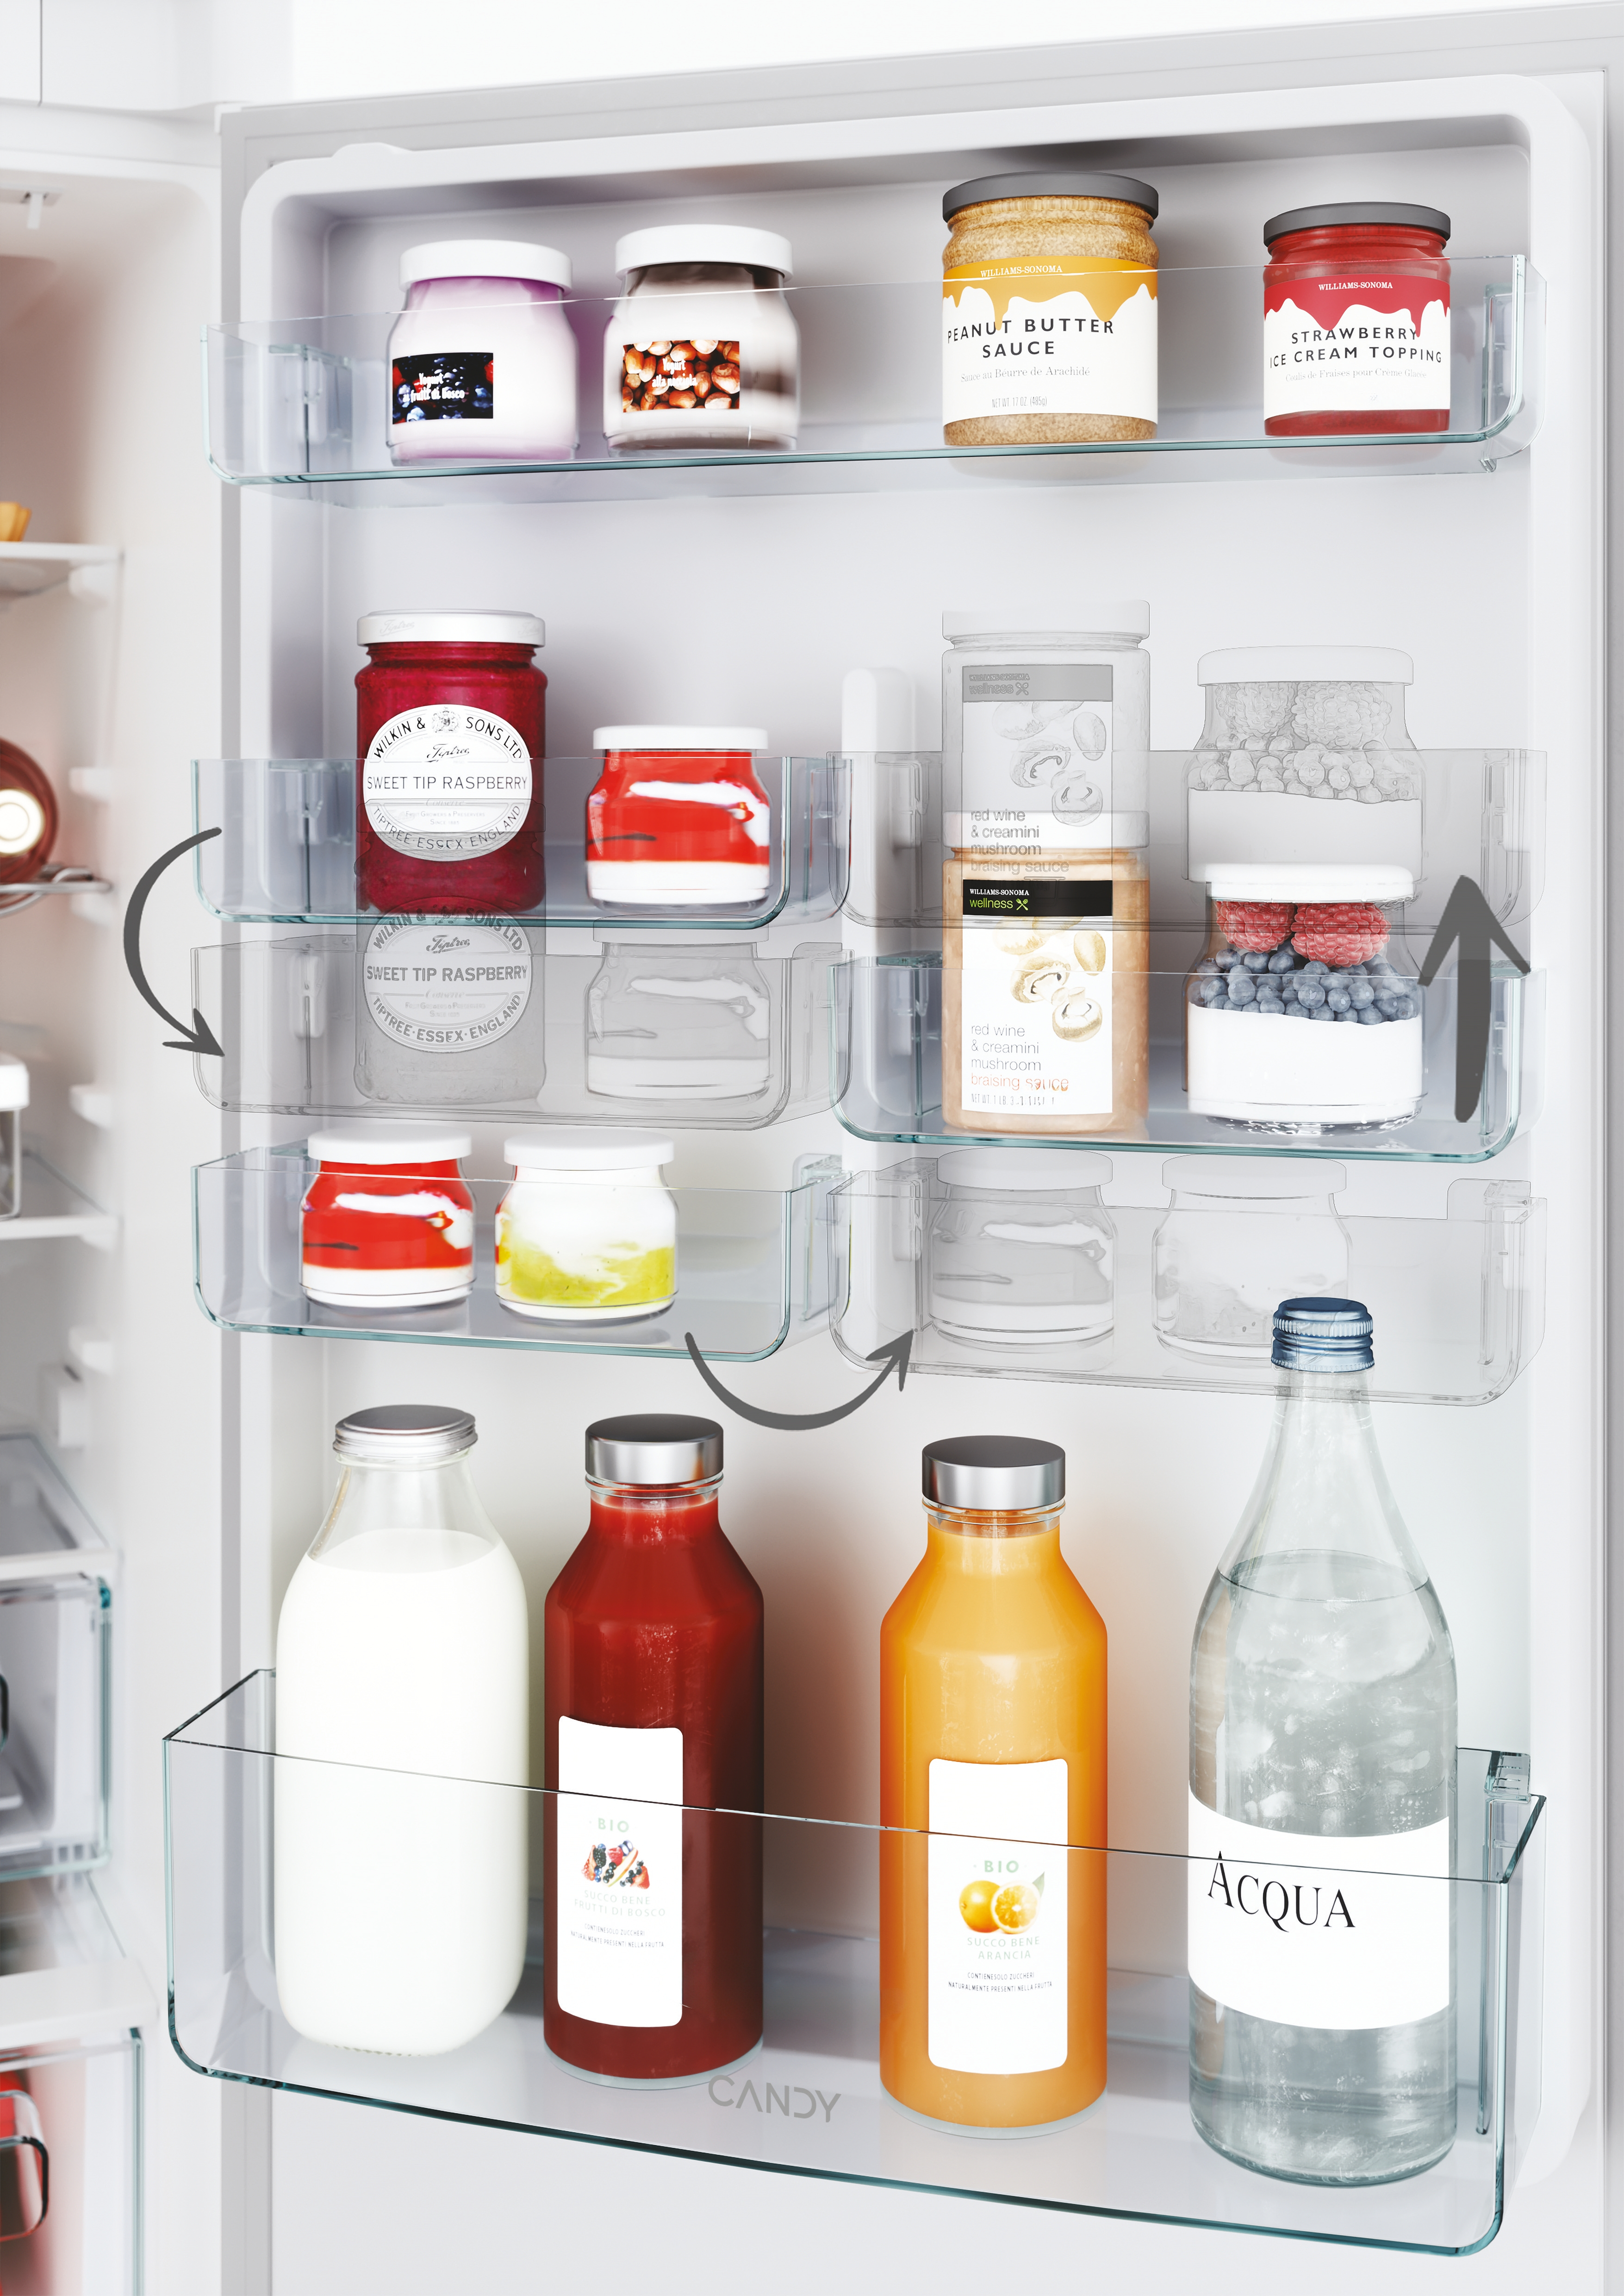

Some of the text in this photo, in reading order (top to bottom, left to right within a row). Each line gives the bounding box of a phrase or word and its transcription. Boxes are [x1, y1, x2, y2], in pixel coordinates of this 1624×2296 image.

[980, 265, 1063, 277] WILLIAMS-SONOMA
[1319, 281, 1393, 291] WILLIAMS-SONOMA
[948, 318, 1114, 343] PEANUT BUTTER
[1291, 327, 1417, 344] STRAWBERRY
[983, 341, 1055, 358] SAUCE
[1270, 347, 1441, 368] ICE CREAM TOPPING
[662, 358, 686, 375] Yogurt
[419, 373, 443, 388] Yogurt
[652, 374, 666, 387] alla
[961, 366, 1090, 382] Sauce au Béurre de Arachidé
[1286, 371, 1306, 382] Coulis
[1319, 368, 1350, 378] Fraises
[1375, 368, 1402, 376] Crème
[1405, 369, 1426, 379] Glacée
[992, 399, 1001, 408] NET
[1013, 397, 1019, 406] 17
[1020, 396, 1028, 406] OZ.
[1030, 396, 1047, 407] (485g)
[969, 682, 1014, 694] wellness
[373, 721, 411, 759] WILKIN
[417, 717, 426, 729] &
[466, 717, 503, 740] SONS
[503, 735, 522, 759] LTD
[367, 776, 527, 790] SWEET TIP RASPBERRY
[971, 808, 1026, 821] red wine
[373, 805, 413, 844] TIPTREE
[470, 806, 520, 847] ENGLAND
[971, 825, 1039, 838] & creamini
[971, 842, 1041, 855] mushroom
[971, 859, 1069, 875] braising sauce
[970, 898, 1013, 909] wellness
[373, 907, 523, 950] WILKIN & SONS LTD
[367, 966, 528, 981] SWEET TIP RASPBERRY
[373, 995, 521, 1042] TIPTREE ESSEX ENGLAND
[971, 1023, 1025, 1036] red wine
[971, 1039, 1039, 1054] & creamini
[971, 1058, 1041, 1071] mushroom
[971, 1073, 1020, 1091] braising
[971, 1093, 980, 1103] NET
[597, 1817, 629, 1833] BIO
[984, 1860, 1019, 1873] BIO
[585, 1890, 651, 1904] SUCCO BENE
[574, 1899, 665, 1916] FRUTTI DI BOSCO
[967, 1936, 1040, 1947] SUCCO BENE
[978, 1950, 1031, 1960] ARANCIA
[1010, 1972, 1034, 1980] ZUCCHERI
[948, 1981, 989, 1992] NATURALMENTE
[1035, 1981, 1052, 1990] FRUTTA
